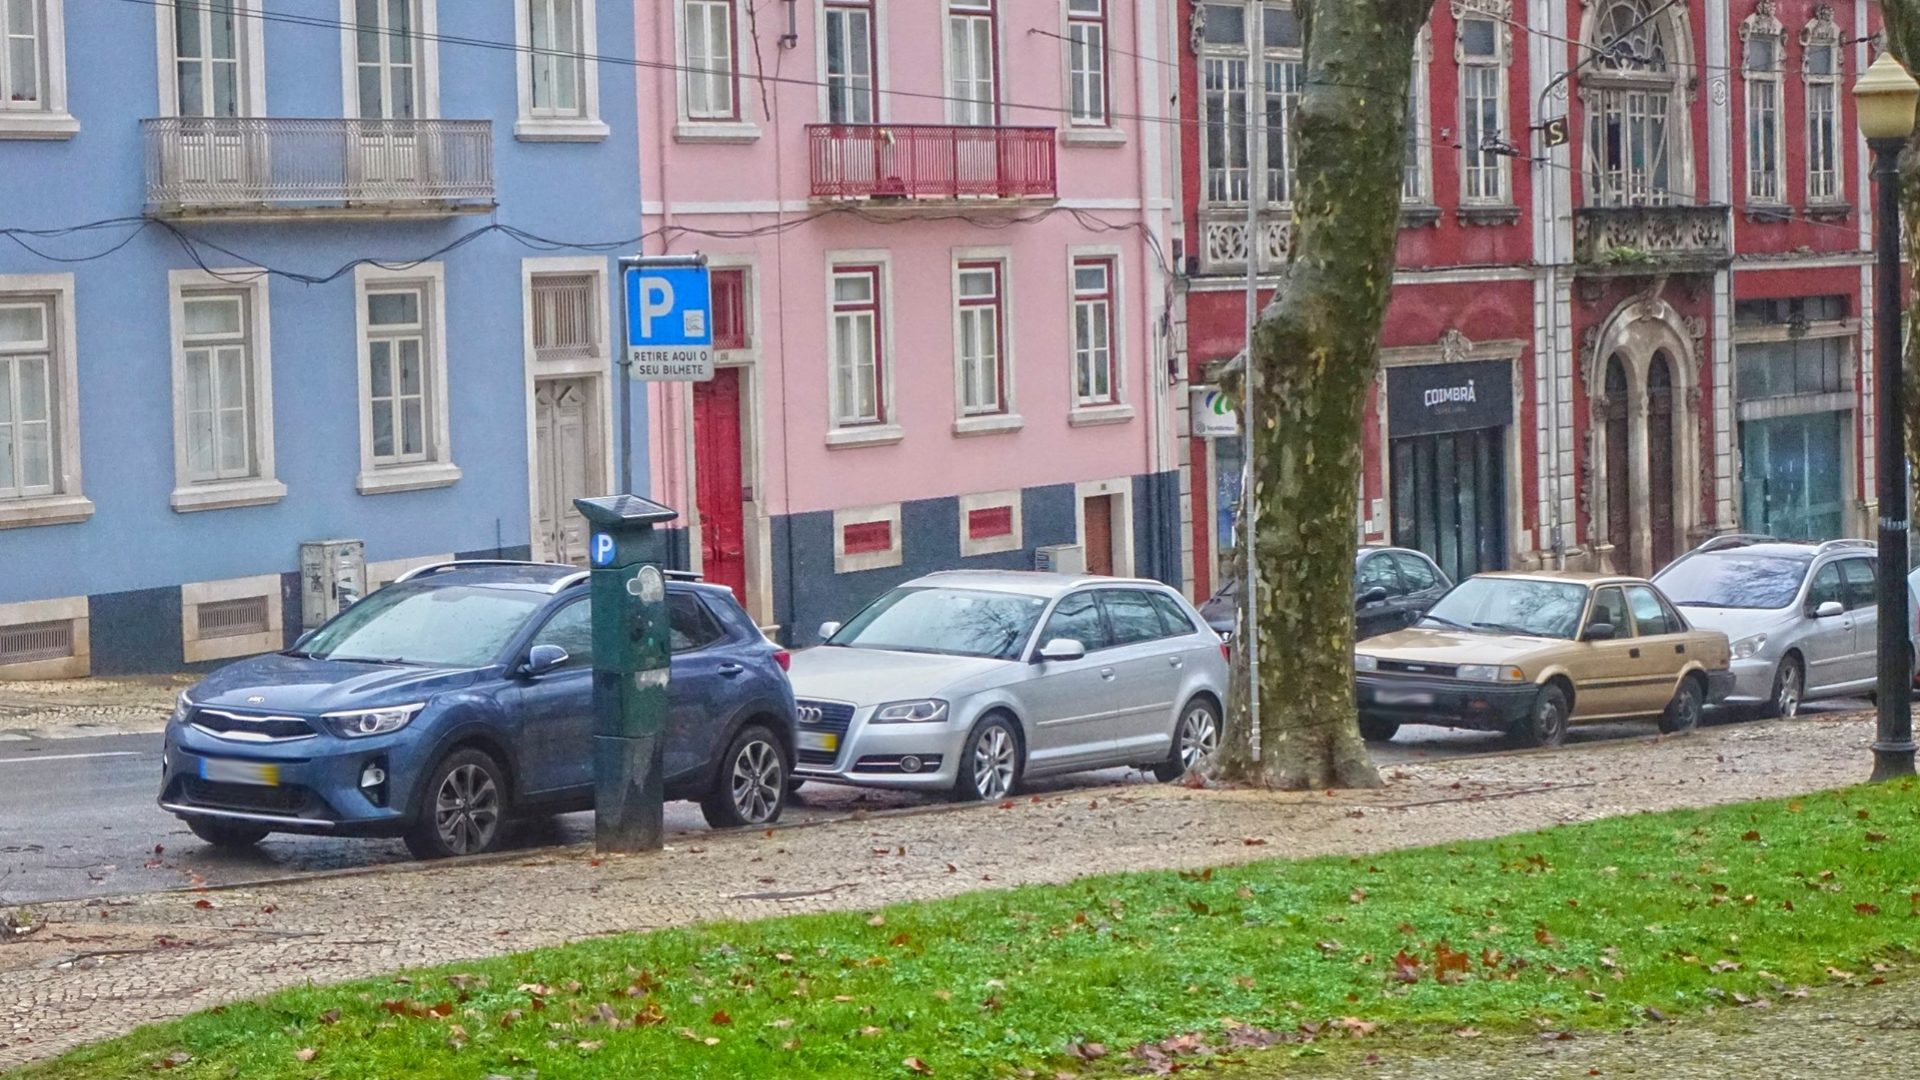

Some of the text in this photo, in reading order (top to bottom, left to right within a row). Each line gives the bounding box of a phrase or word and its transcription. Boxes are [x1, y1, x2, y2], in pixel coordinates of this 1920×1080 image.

[1549, 121, 1564, 145] S
[639, 276, 674, 338] P
[634, 351, 669, 361] RETIRE
[672, 351, 697, 362] AQUI
[699, 350, 707, 361] O
[639, 364, 704, 375] SEU BILHETE
[597, 533, 613, 563] P
